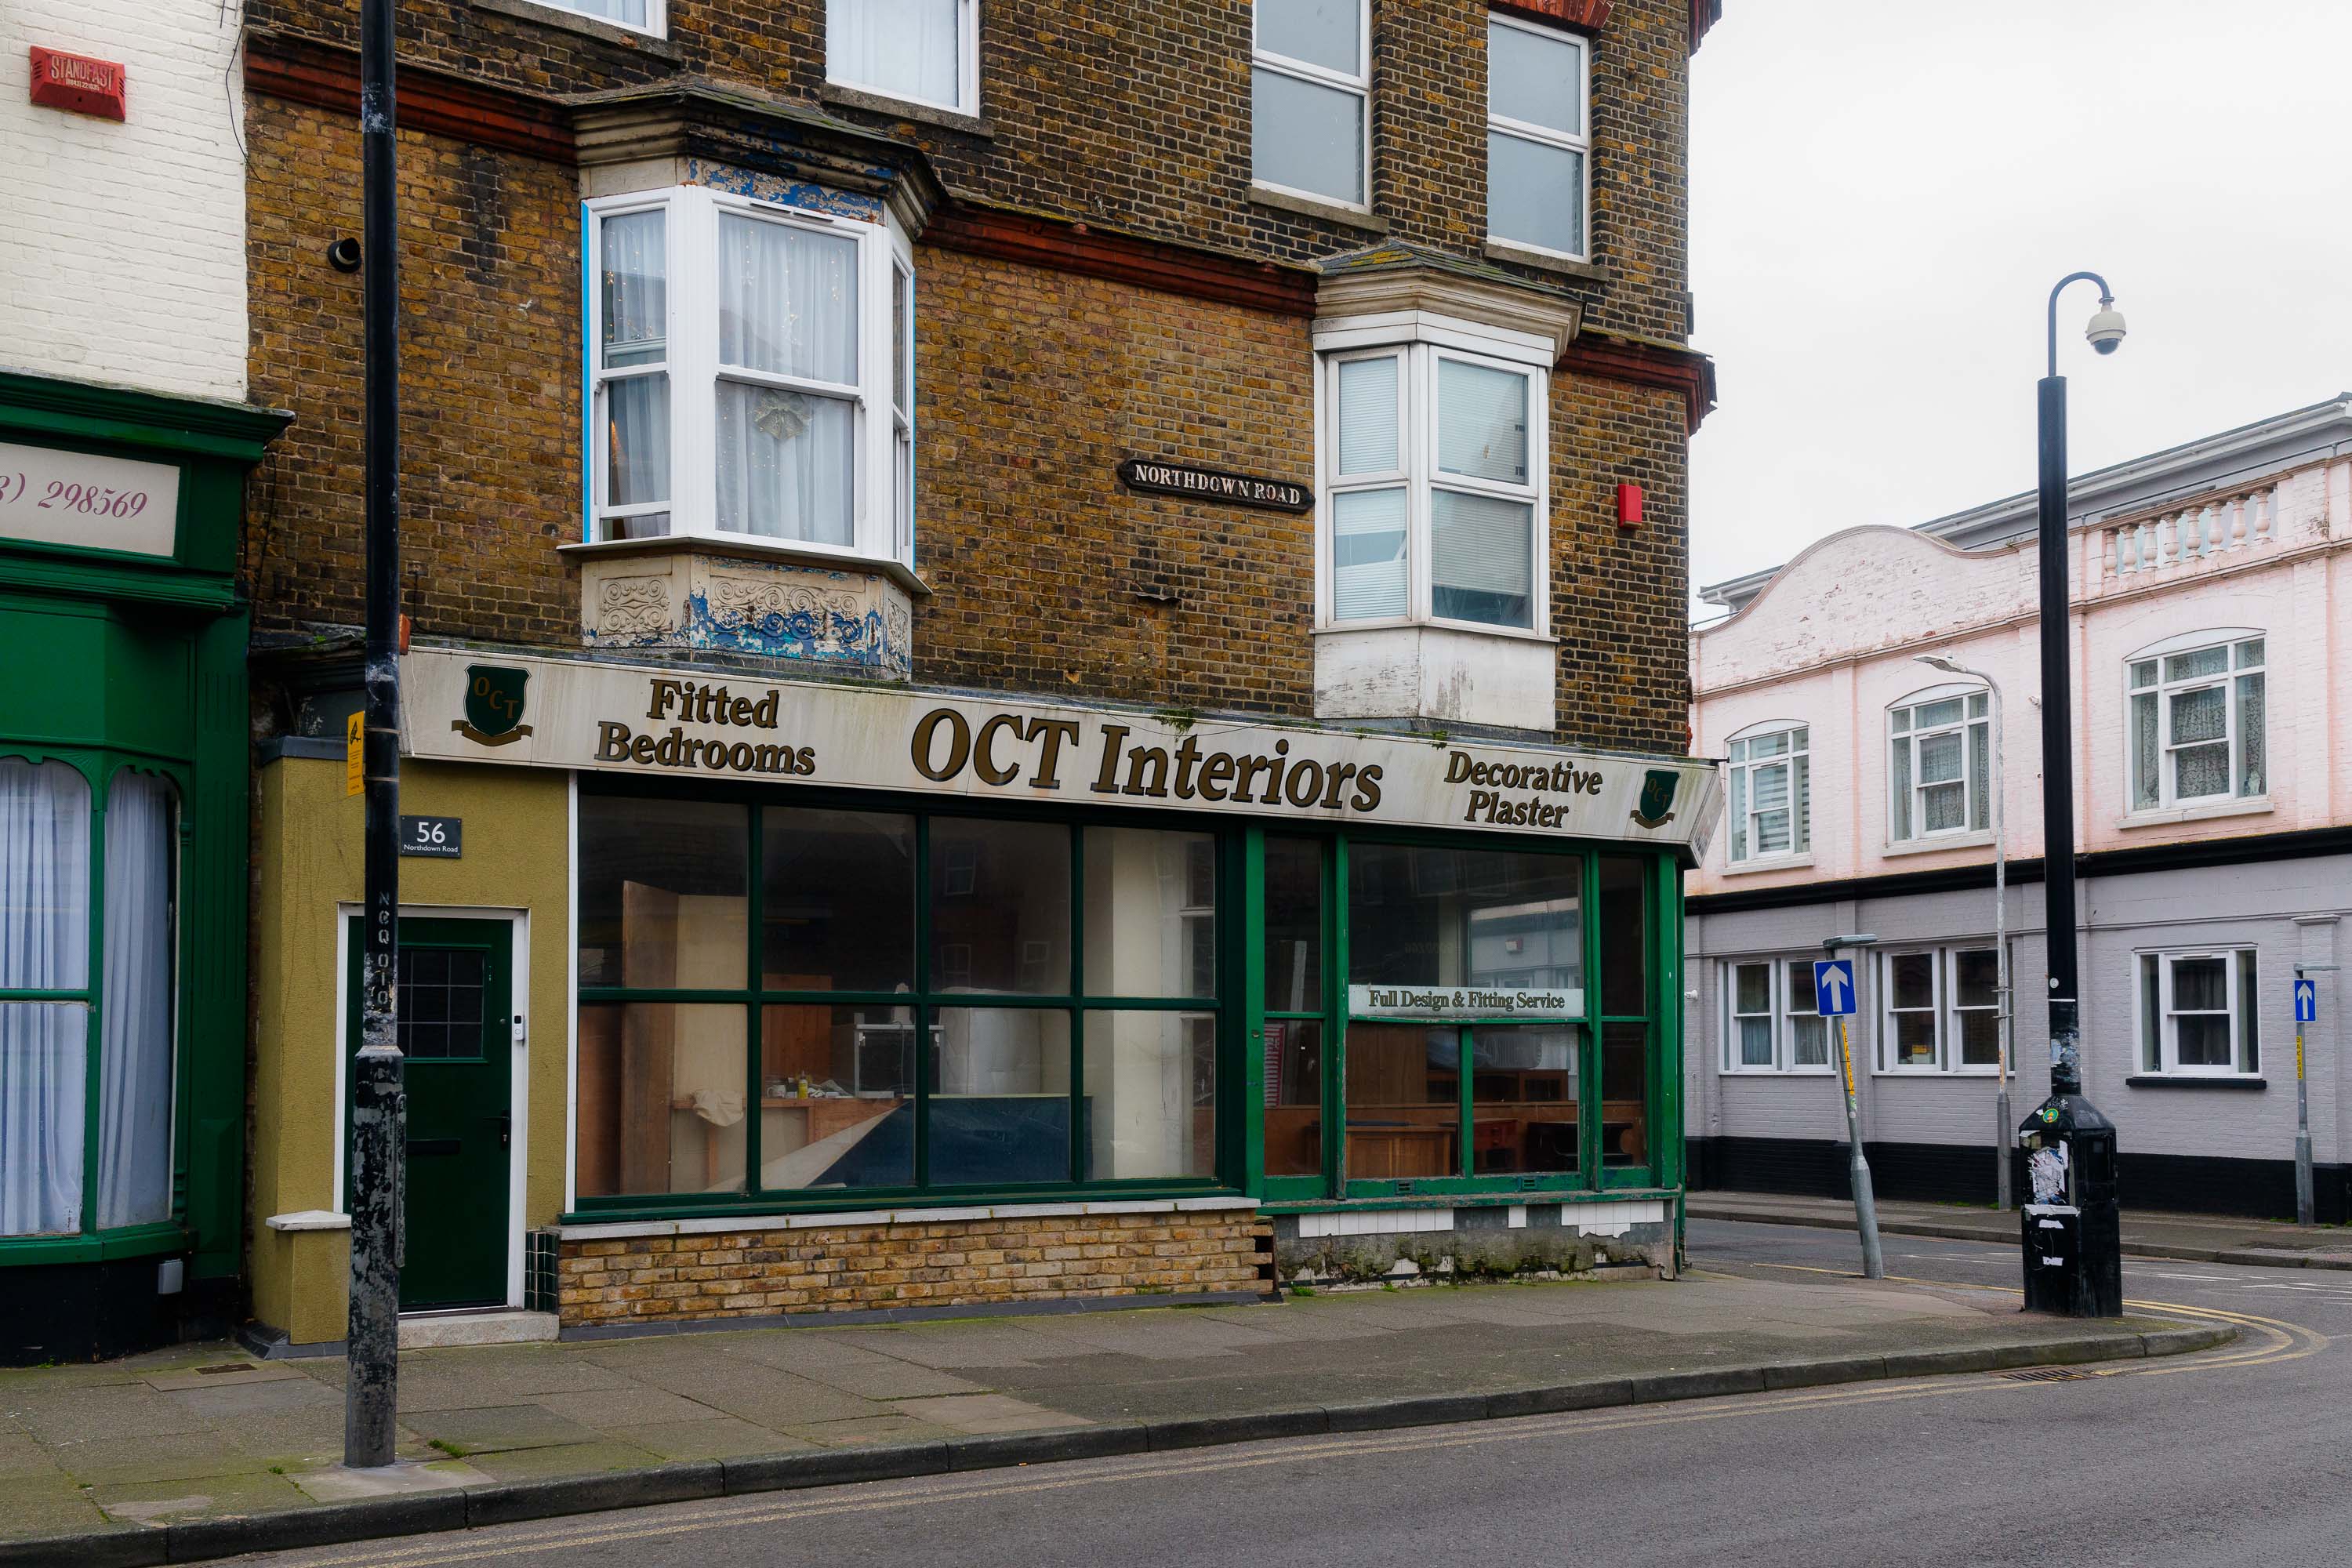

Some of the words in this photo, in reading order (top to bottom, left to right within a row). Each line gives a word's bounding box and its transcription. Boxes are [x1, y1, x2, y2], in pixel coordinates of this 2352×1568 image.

[51, 55, 114, 92] STANDFAST
[38, 481, 147, 518] 298569
[1134, 464, 1250, 498] NORTHDOWN
[1254, 482, 1301, 505] ROAD
[474, 677, 520, 720] OCT
[646, 678, 780, 729] Fitted
[593, 720, 816, 776] Bedrooms
[911, 708, 1080, 789] OCT
[1090, 723, 1384, 812] Interiors
[1443, 750, 1603, 795] Decorative
[1647, 777, 1670, 808] OCT
[1464, 789, 1570, 829] Plaster
[404, 844, 441, 852] Northdown
[416, 821, 445, 844] 56
[1368, 989, 1398, 1008] Full
[1400, 990, 1450, 1012] Design
[1452, 991, 1465, 1008] &
[1467, 991, 1514, 1012] Fitting
[1516, 991, 1566, 1009] Service
